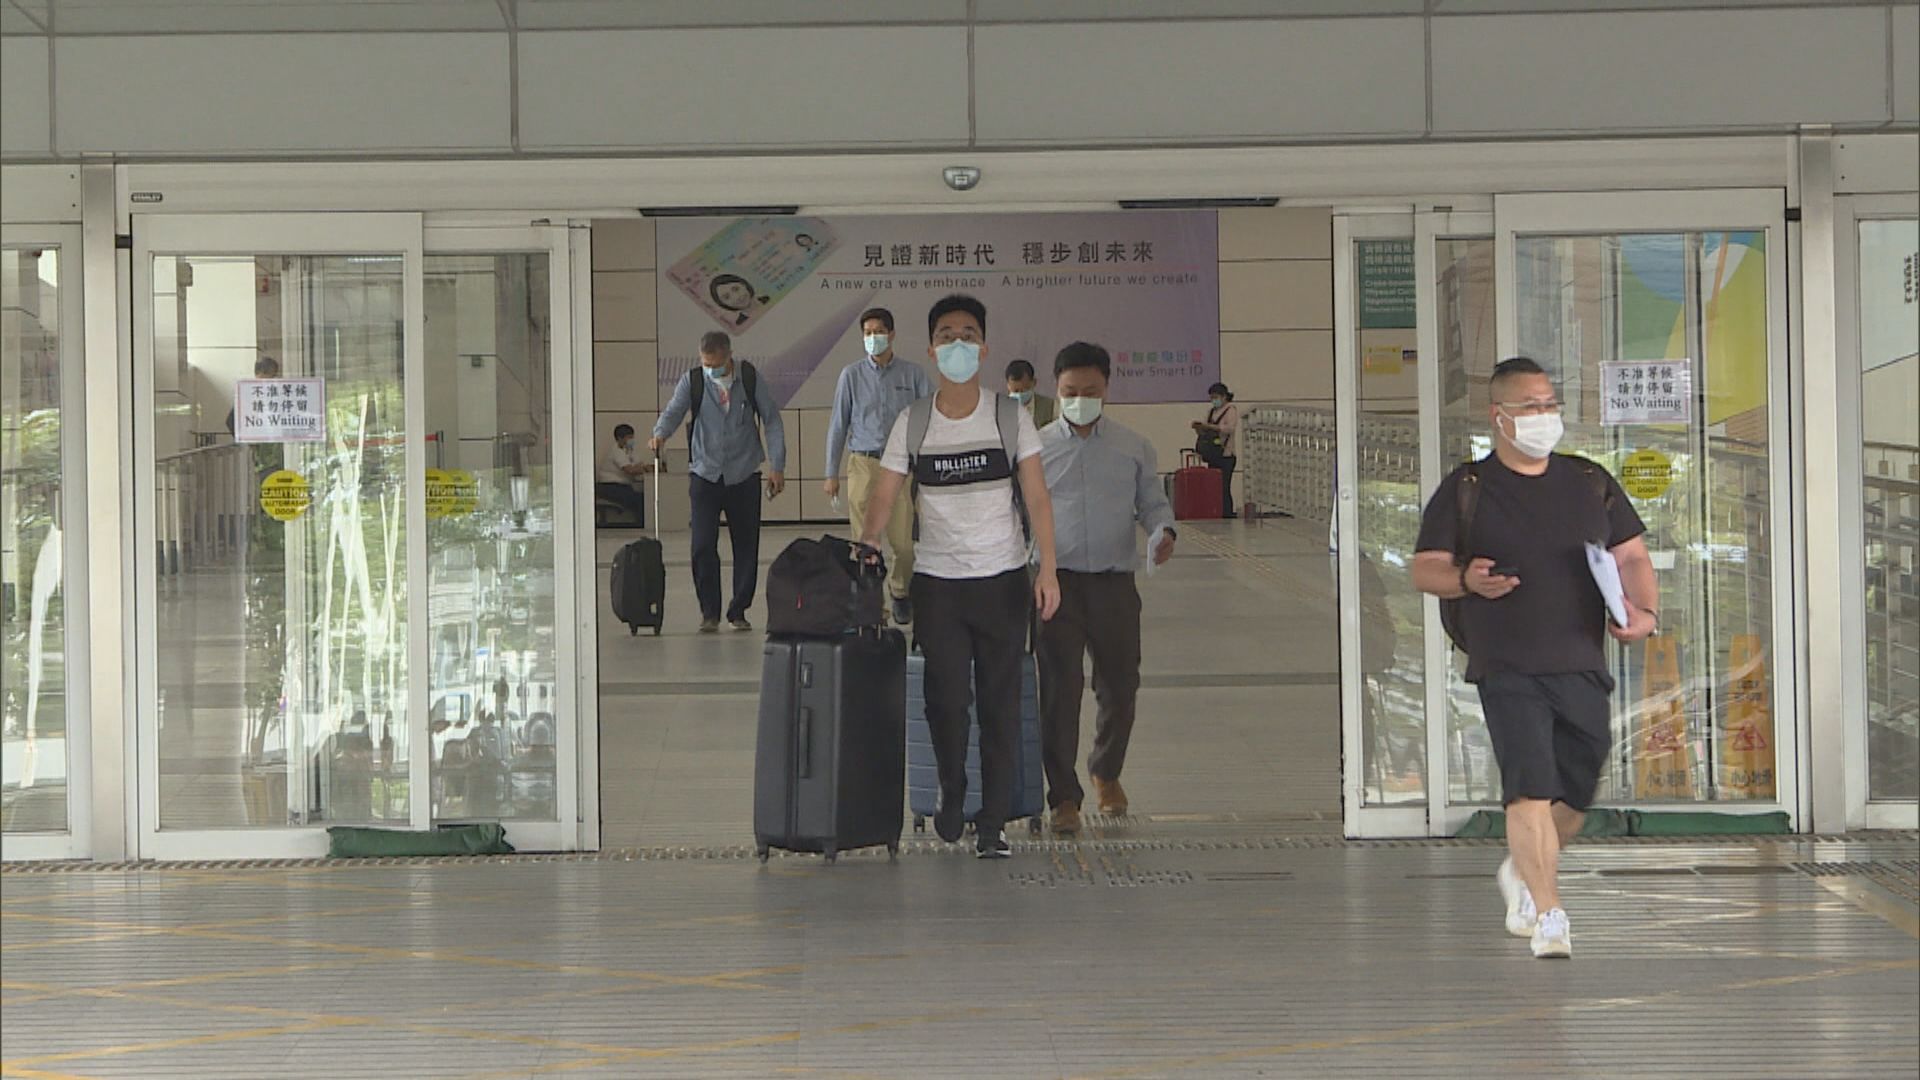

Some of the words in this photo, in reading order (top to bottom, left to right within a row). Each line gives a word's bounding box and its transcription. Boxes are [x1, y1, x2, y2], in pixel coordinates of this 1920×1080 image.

[864, 244, 995, 267] 見證新時代
[1022, 241, 1153, 264] 穩步創未來
[820, 278, 830, 289] A
[835, 279, 864, 289] new
[870, 278, 893, 289] era
[899, 279, 918, 289] we
[924, 276, 985, 289] embrace
[1002, 275, 1011, 286] A
[1016, 274, 1072, 288] brighter
[1079, 273, 1121, 286] future
[1127, 274, 1147, 284] we
[1152, 273, 1198, 285] create
[1116, 366, 1144, 377] New
[1149, 366, 1185, 377] Smart
[1189, 364, 1203, 376] ID
[1618, 366, 1673, 380] 不准等候
[252, 384, 308, 397] 不准等候
[1618, 382, 1673, 395] 請勿停留
[252, 400, 308, 413] 請勿停留
[1611, 398, 1629, 409] No
[1633, 396, 1681, 411] Waiting
[245, 415, 263, 427] No
[268, 414, 316, 429] Waiting
[934, 454, 987, 471] HOLLISTER
